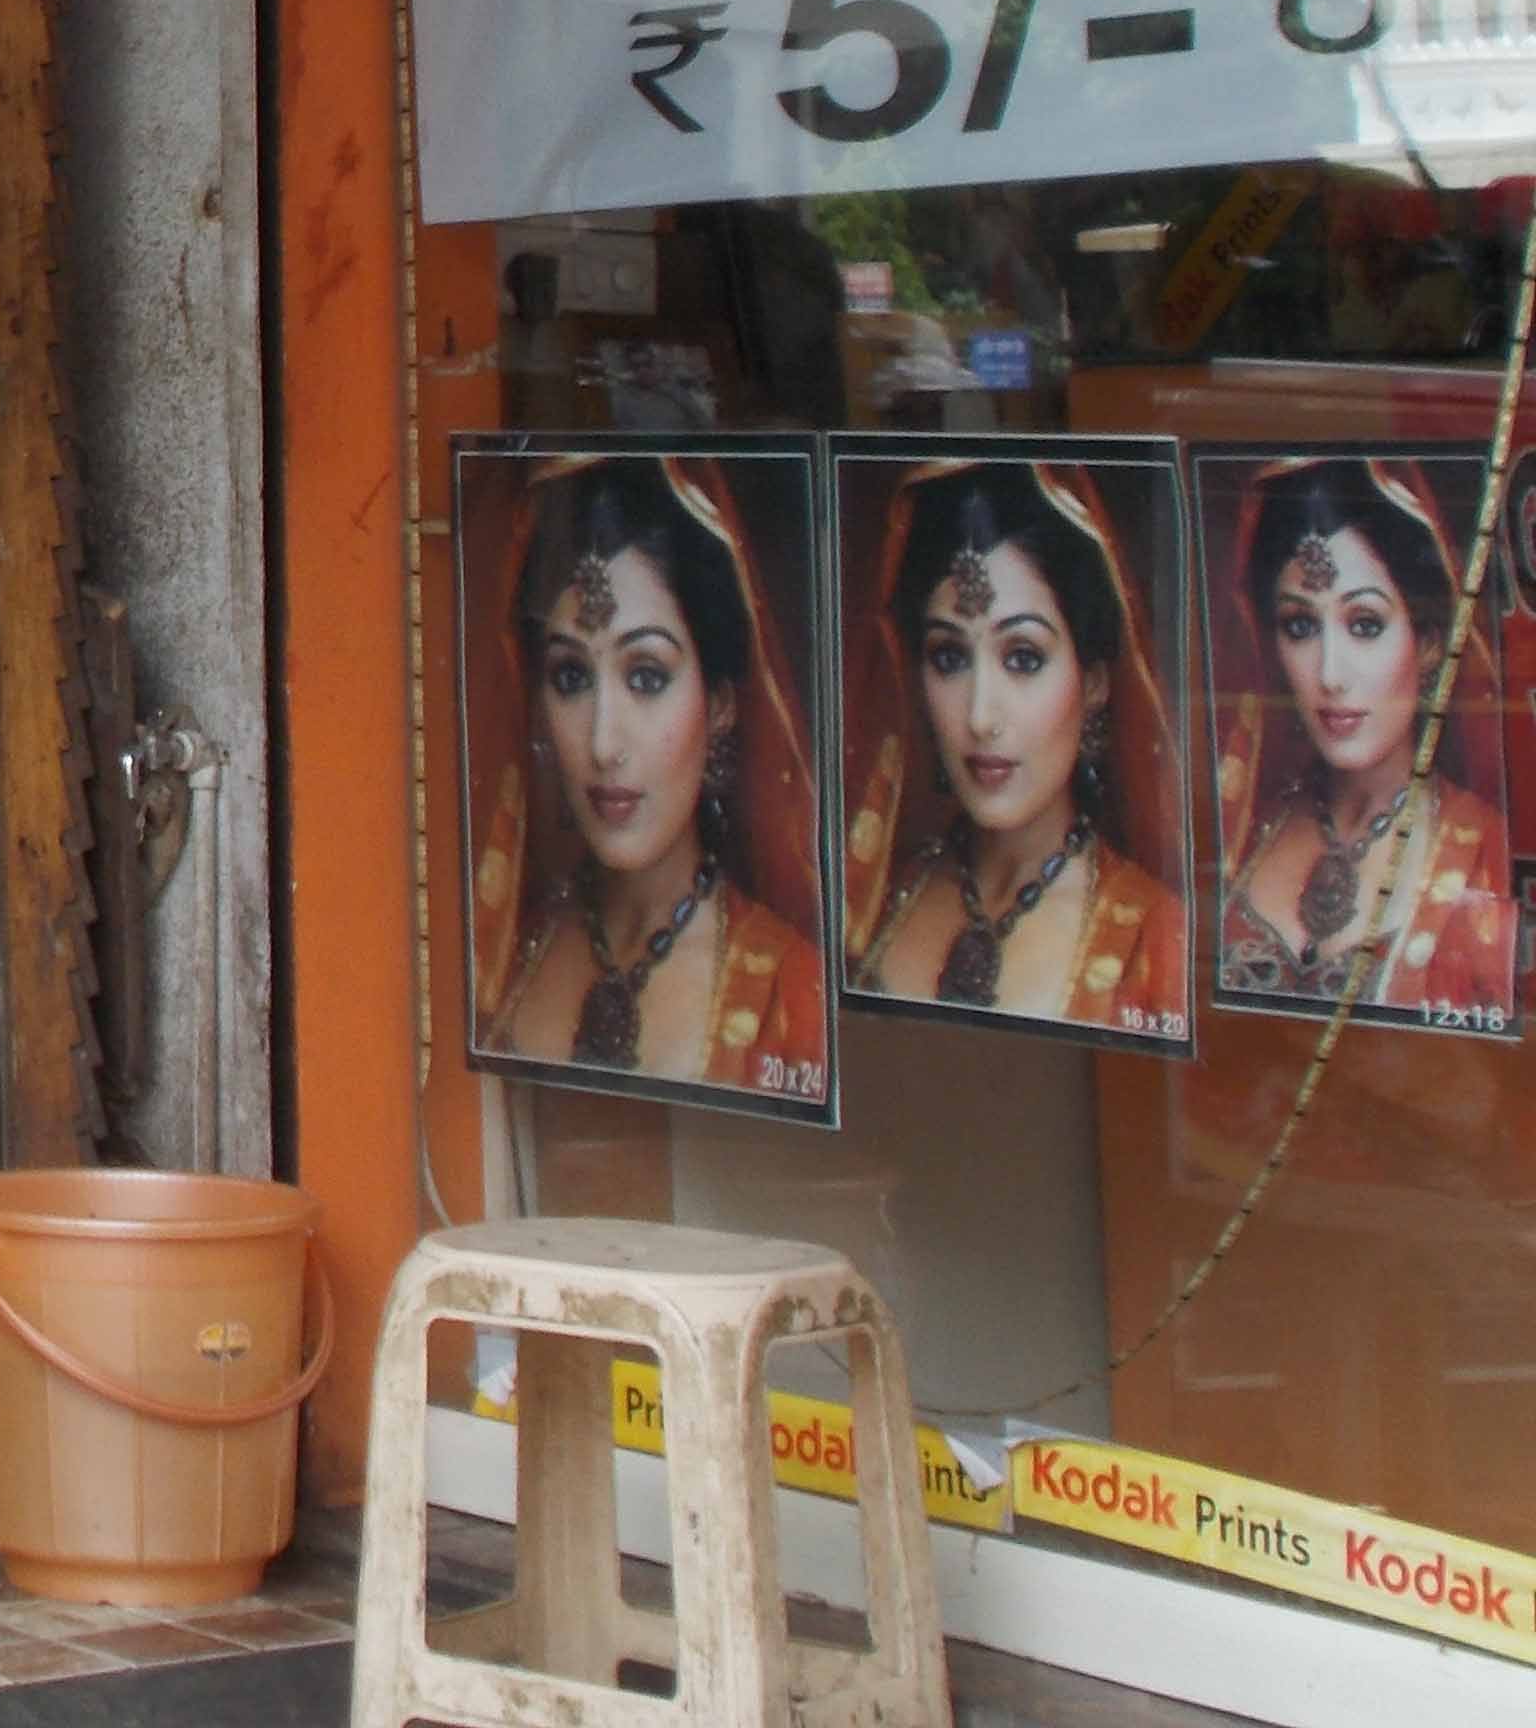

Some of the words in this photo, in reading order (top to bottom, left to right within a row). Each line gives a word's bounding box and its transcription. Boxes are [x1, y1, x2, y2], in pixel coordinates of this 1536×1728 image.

[1160, 1009, 1186, 1036] 20
[760, 1054, 785, 1090] 20
[800, 1060, 823, 1094] 24
[1031, 1444, 1179, 1530] Kodak
[1195, 1493, 1311, 1567] Prints
[1344, 1528, 1514, 1629] Kodak
